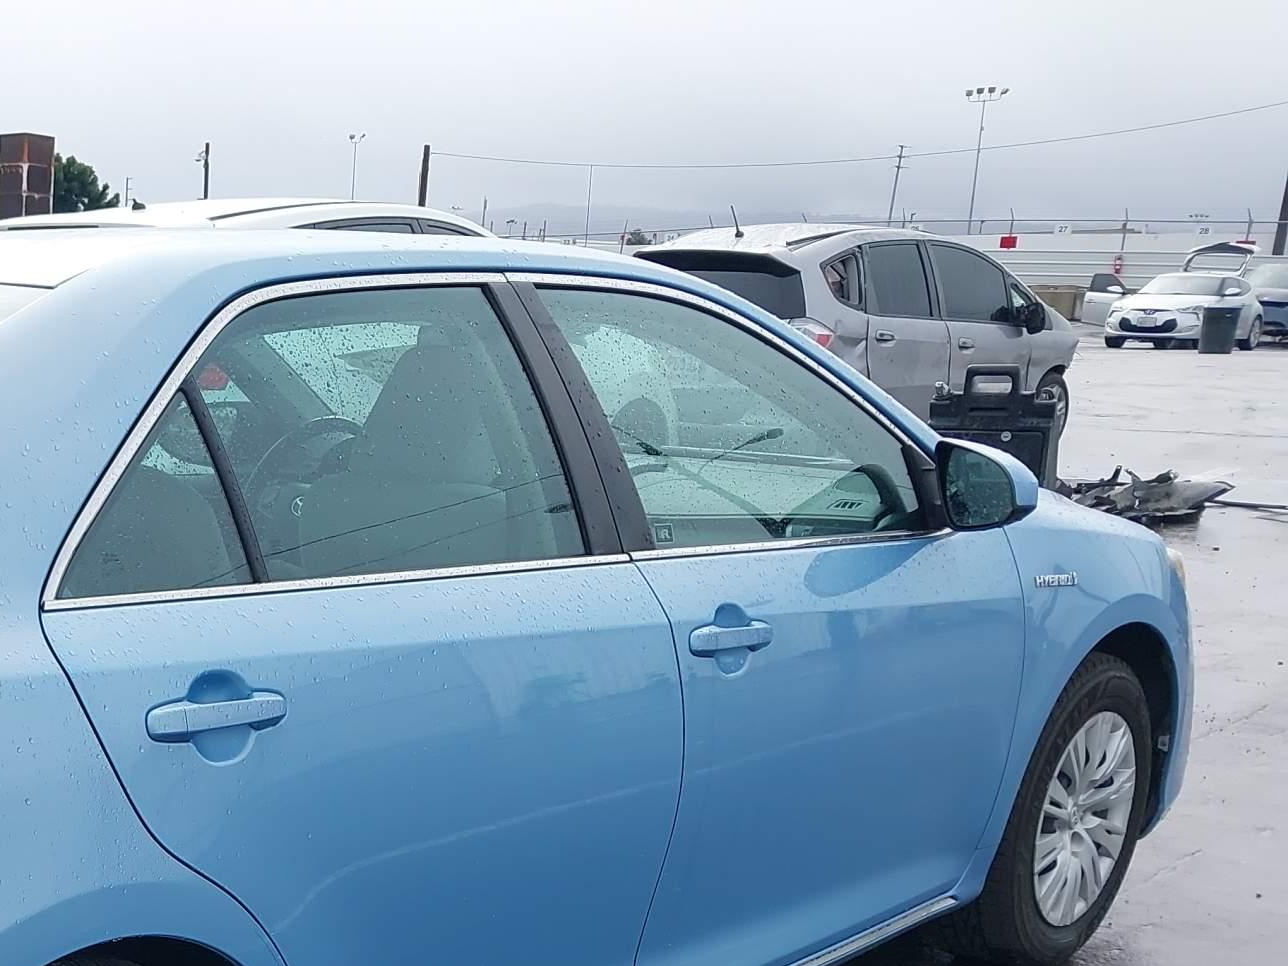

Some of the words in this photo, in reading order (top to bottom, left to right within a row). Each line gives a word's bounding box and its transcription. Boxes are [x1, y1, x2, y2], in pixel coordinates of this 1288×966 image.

[1058, 225, 1068, 233] 27
[1199, 227, 1210, 235] 28
[1034, 573, 1075, 587] HYBRID
